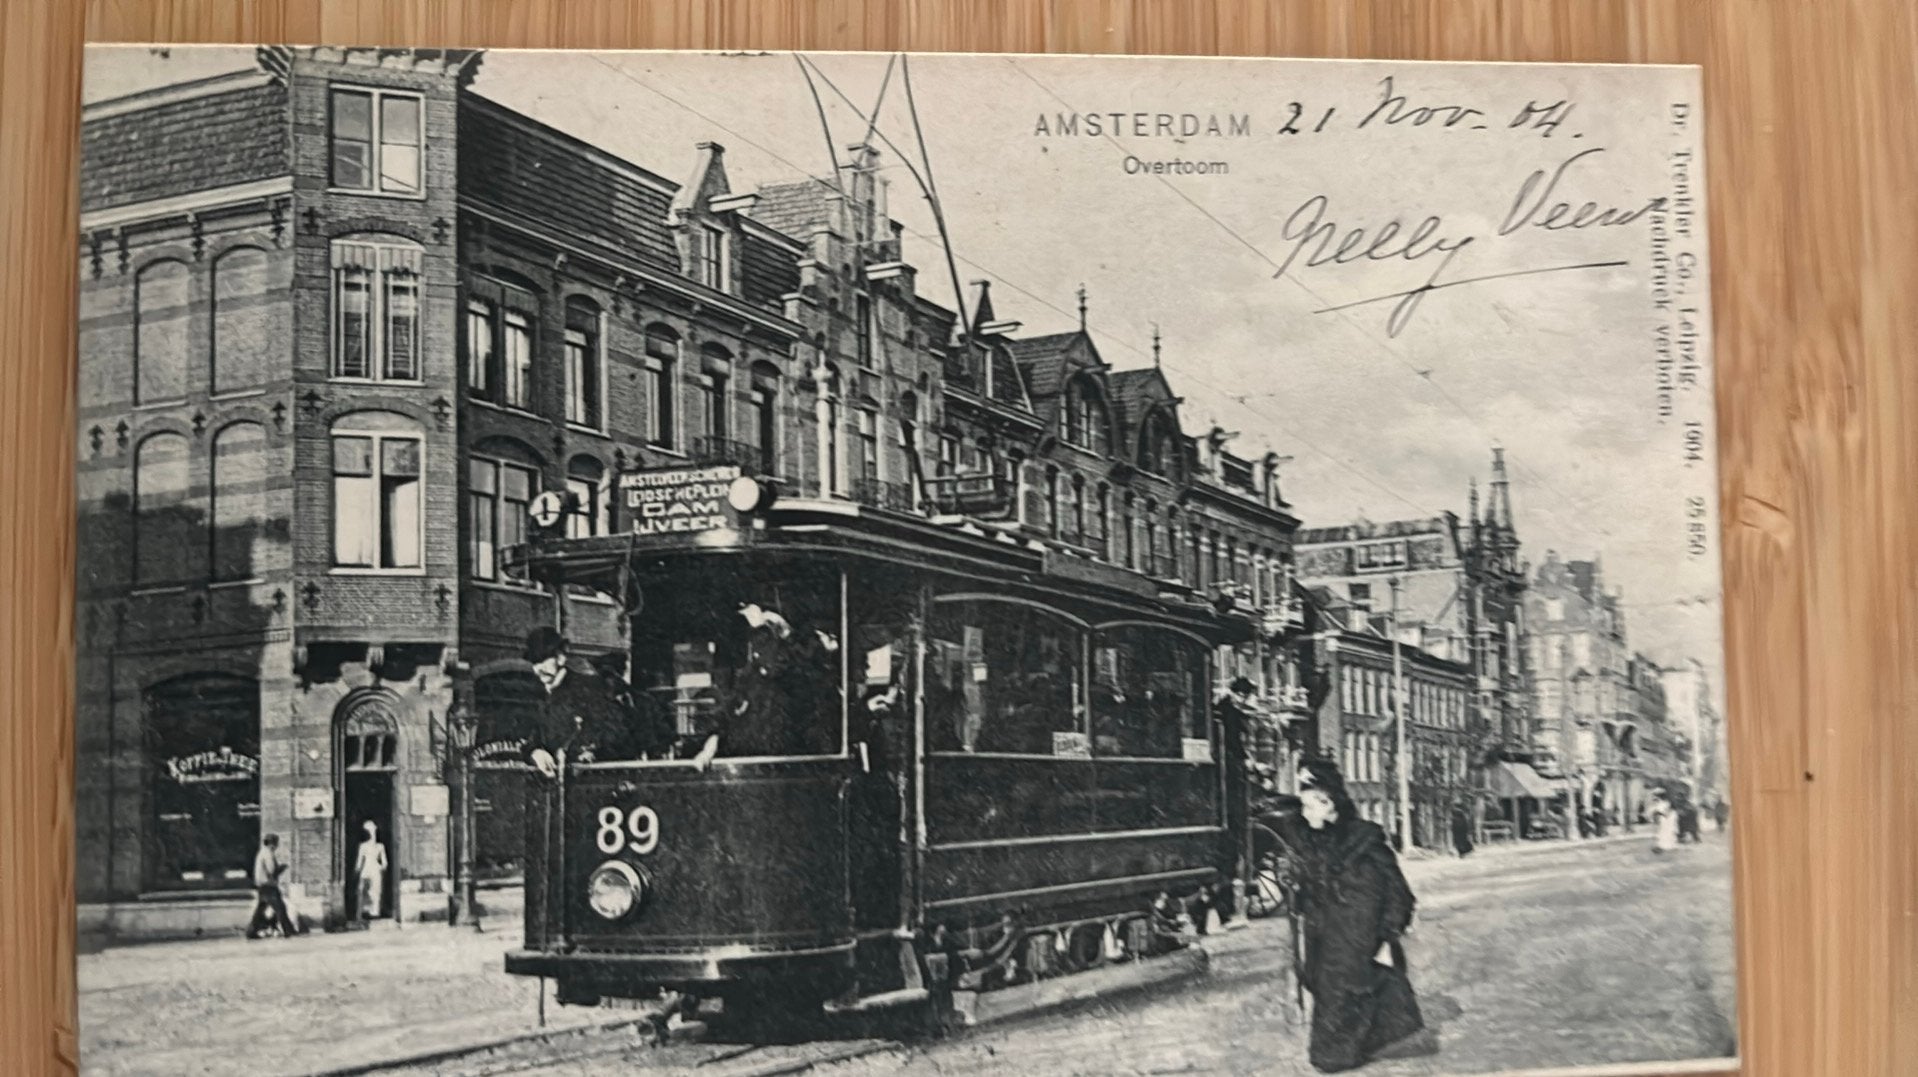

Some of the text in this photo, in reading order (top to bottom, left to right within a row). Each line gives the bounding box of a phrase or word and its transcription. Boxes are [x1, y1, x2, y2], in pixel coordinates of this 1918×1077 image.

[1034, 112, 1250, 137] AMSTERDAM
[1278, 102, 1335, 134] 21
[1123, 155, 1229, 175] Overtoom
[1671, 150, 1695, 238] Trenkler
[1272, 195, 1474, 338] Nelly
[1650, 198, 1673, 308] Nachdruck
[642, 500, 719, 517] DAM
[596, 805, 660, 855] 89
